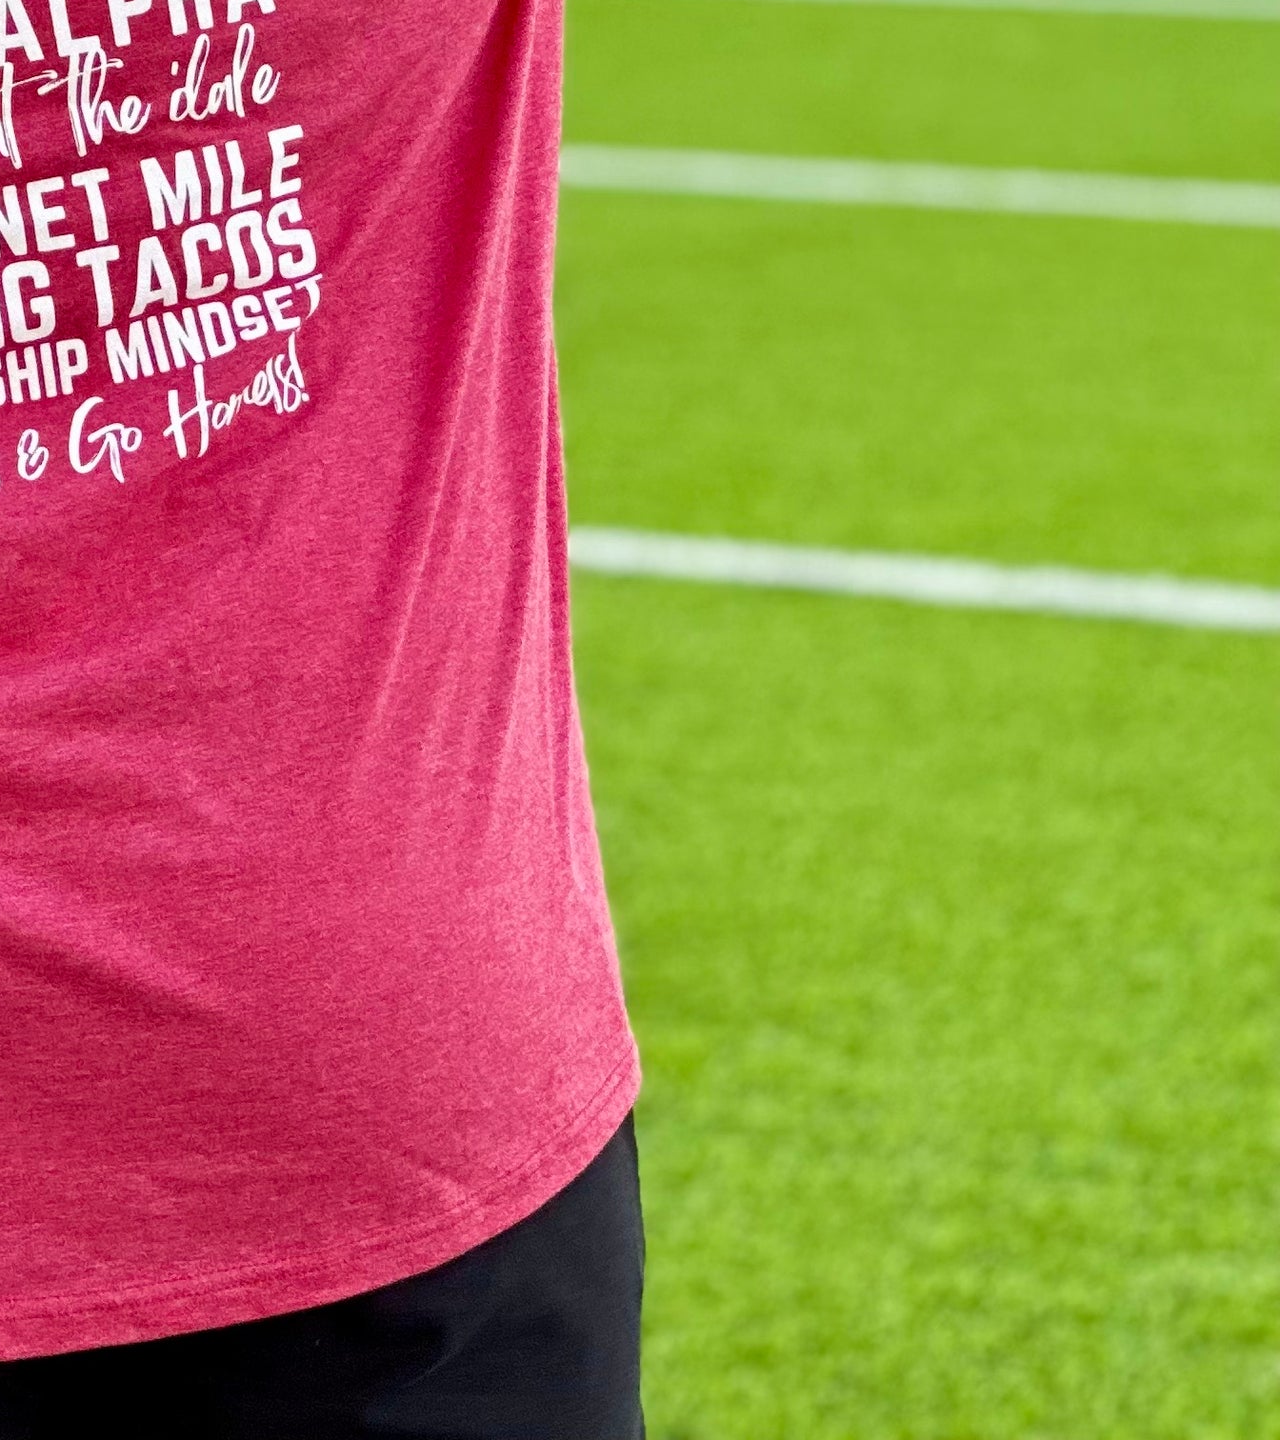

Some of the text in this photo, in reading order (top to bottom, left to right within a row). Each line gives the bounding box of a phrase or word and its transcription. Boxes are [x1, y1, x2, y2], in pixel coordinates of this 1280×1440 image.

[148, 124, 307, 232] MILE
[78, 198, 318, 327] TACOS
[105, 273, 323, 384] MINDSET
[68, 396, 143, 484] Go
